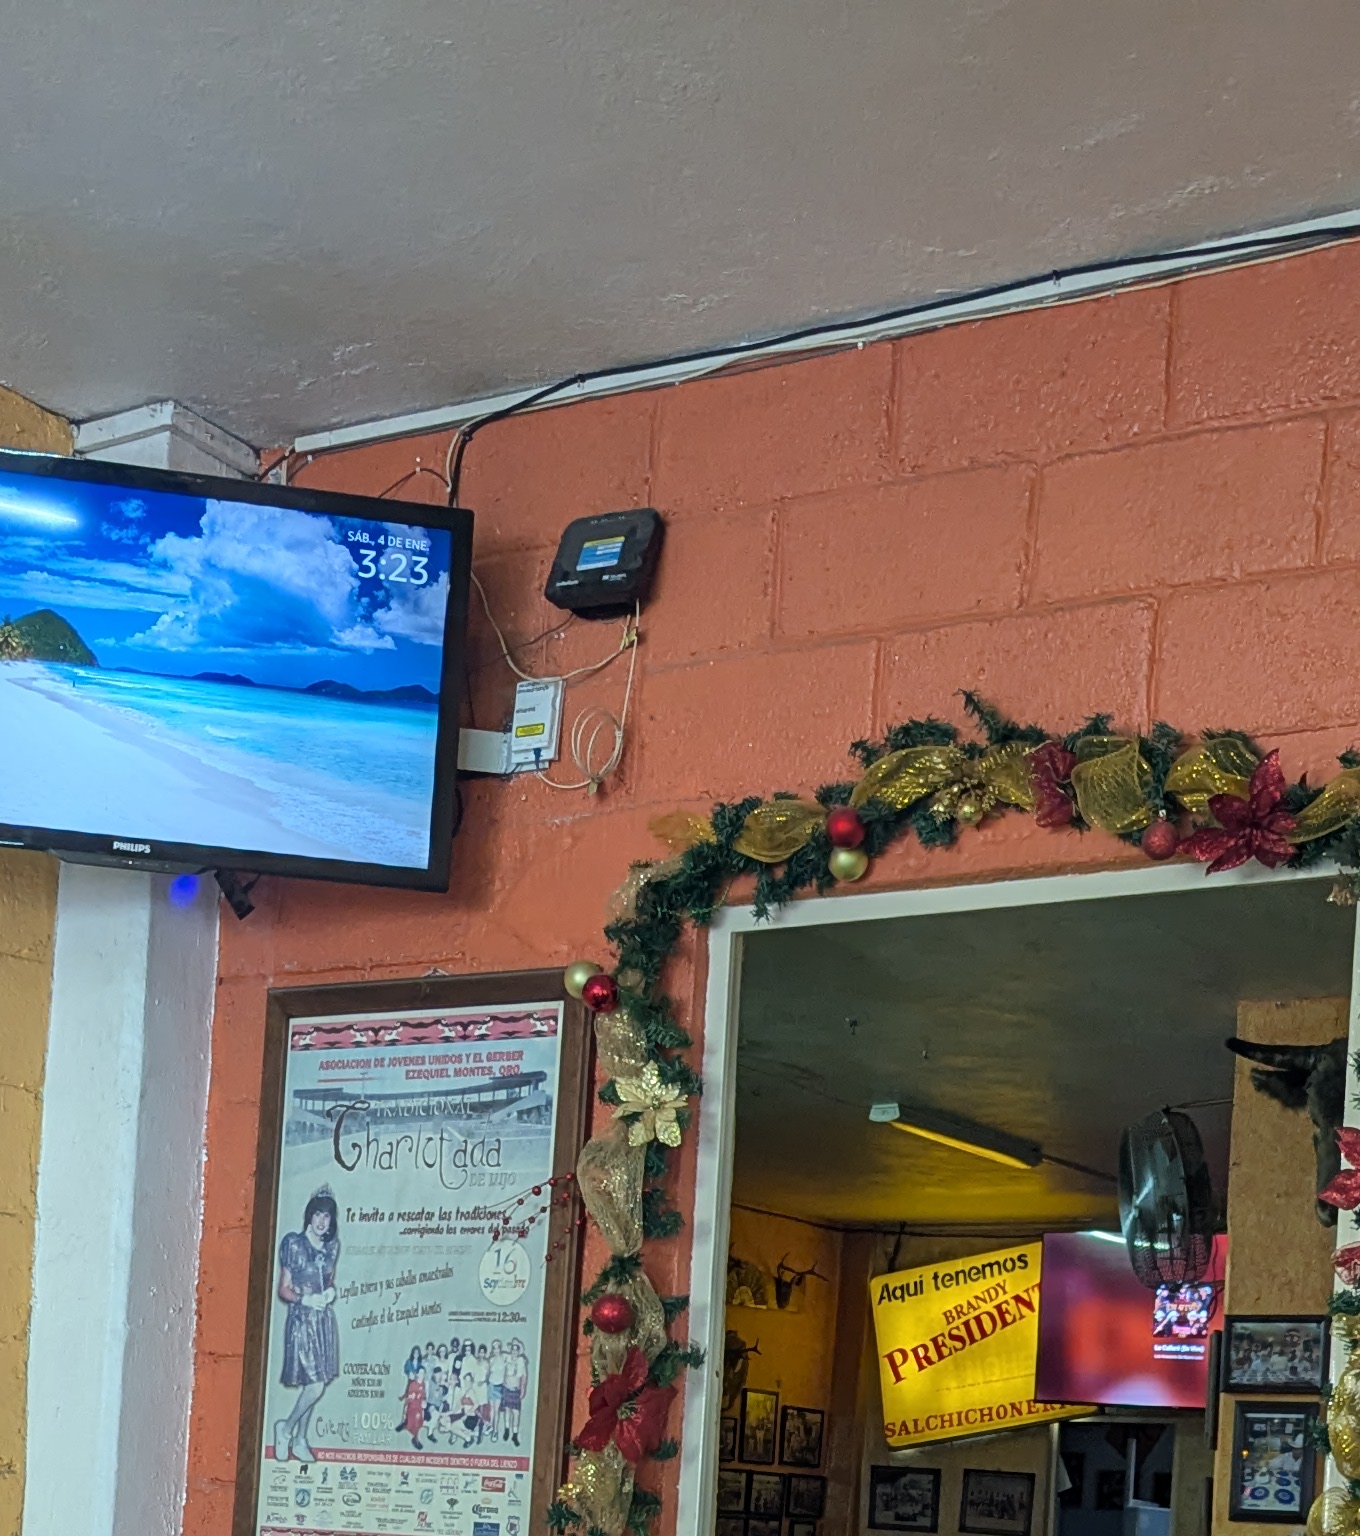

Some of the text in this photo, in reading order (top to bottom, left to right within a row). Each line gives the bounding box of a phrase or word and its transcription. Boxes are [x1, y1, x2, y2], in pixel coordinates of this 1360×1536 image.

[377, 534, 385, 545] 4
[387, 536, 403, 548] DE
[358, 549, 429, 585] 3:23
[113, 841, 151, 854] PHILIPS
[319, 1057, 372, 1070] ASOCIACION
[374, 1056, 385, 1068] DE
[387, 1055, 426, 1067] JOVENES
[428, 1053, 463, 1066] UNIDOS
[465, 1053, 471, 1064] Y
[473, 1052, 484, 1063] EL
[405, 1068, 451, 1080] EZEQUIEL
[375, 1098, 474, 1118] TRADICIONAL
[345, 1207, 356, 1223] Te
[358, 1206, 385, 1223] invita
[388, 1213, 394, 1222] a
[396, 1206, 436, 1222] rescatar
[438, 1204, 452, 1222] las
[446, 1224, 457, 1234] los
[493, 1248, 518, 1275] 16
[932, 1253, 1029, 1291] tenemos
[942, 1279, 1009, 1326] BRANDY
[343, 1360, 391, 1375] COOPERACIÓN
[352, 1412, 394, 1431] 100%
